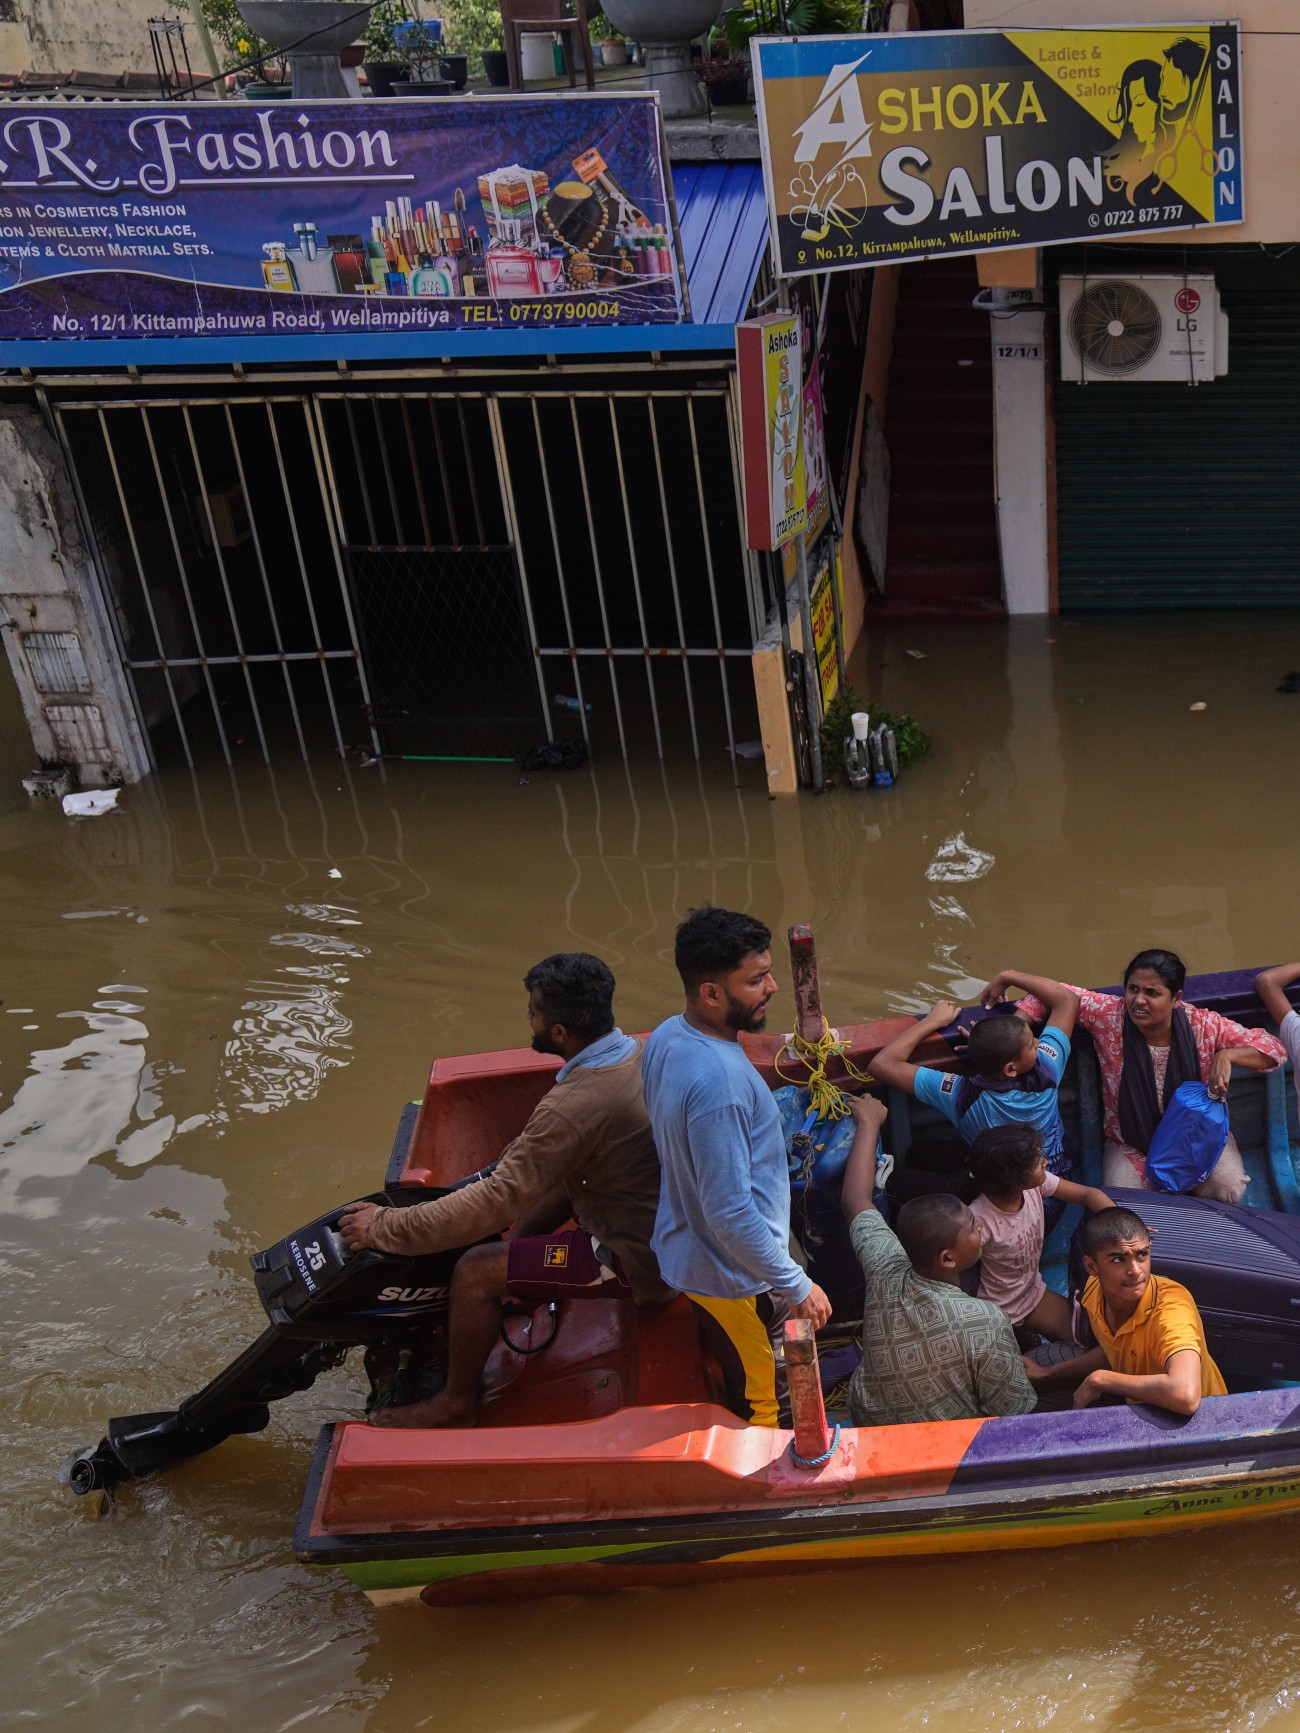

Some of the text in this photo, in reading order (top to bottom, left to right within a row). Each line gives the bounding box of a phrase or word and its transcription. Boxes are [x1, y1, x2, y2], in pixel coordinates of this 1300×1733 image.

[1038, 46, 1102, 62] Ladies &
[1056, 64, 1101, 81] Gents
[1075, 82, 1118, 98] Salon
[1215, 43, 1235, 207] SALON
[128, 109, 398, 195] Fashion
[0, 206, 13, 219] RS
[1104, 204, 1184, 226] 0722 875 737
[45, 245, 55, 257] &
[53, 302, 620, 333] No. 12/1 Kittampahuwa Road, Wellampitiya TEL: 0773790004
[1176, 319, 1198, 332] LG
[768, 328, 799, 355] Ashoka
[997, 346, 1041, 359] 12/1/1
[778, 353, 795, 513] SALON
[303, 1240, 326, 1272] 25
[289, 1239, 317, 1293] KEROSENE
[377, 1286, 450, 1302] SUZU
